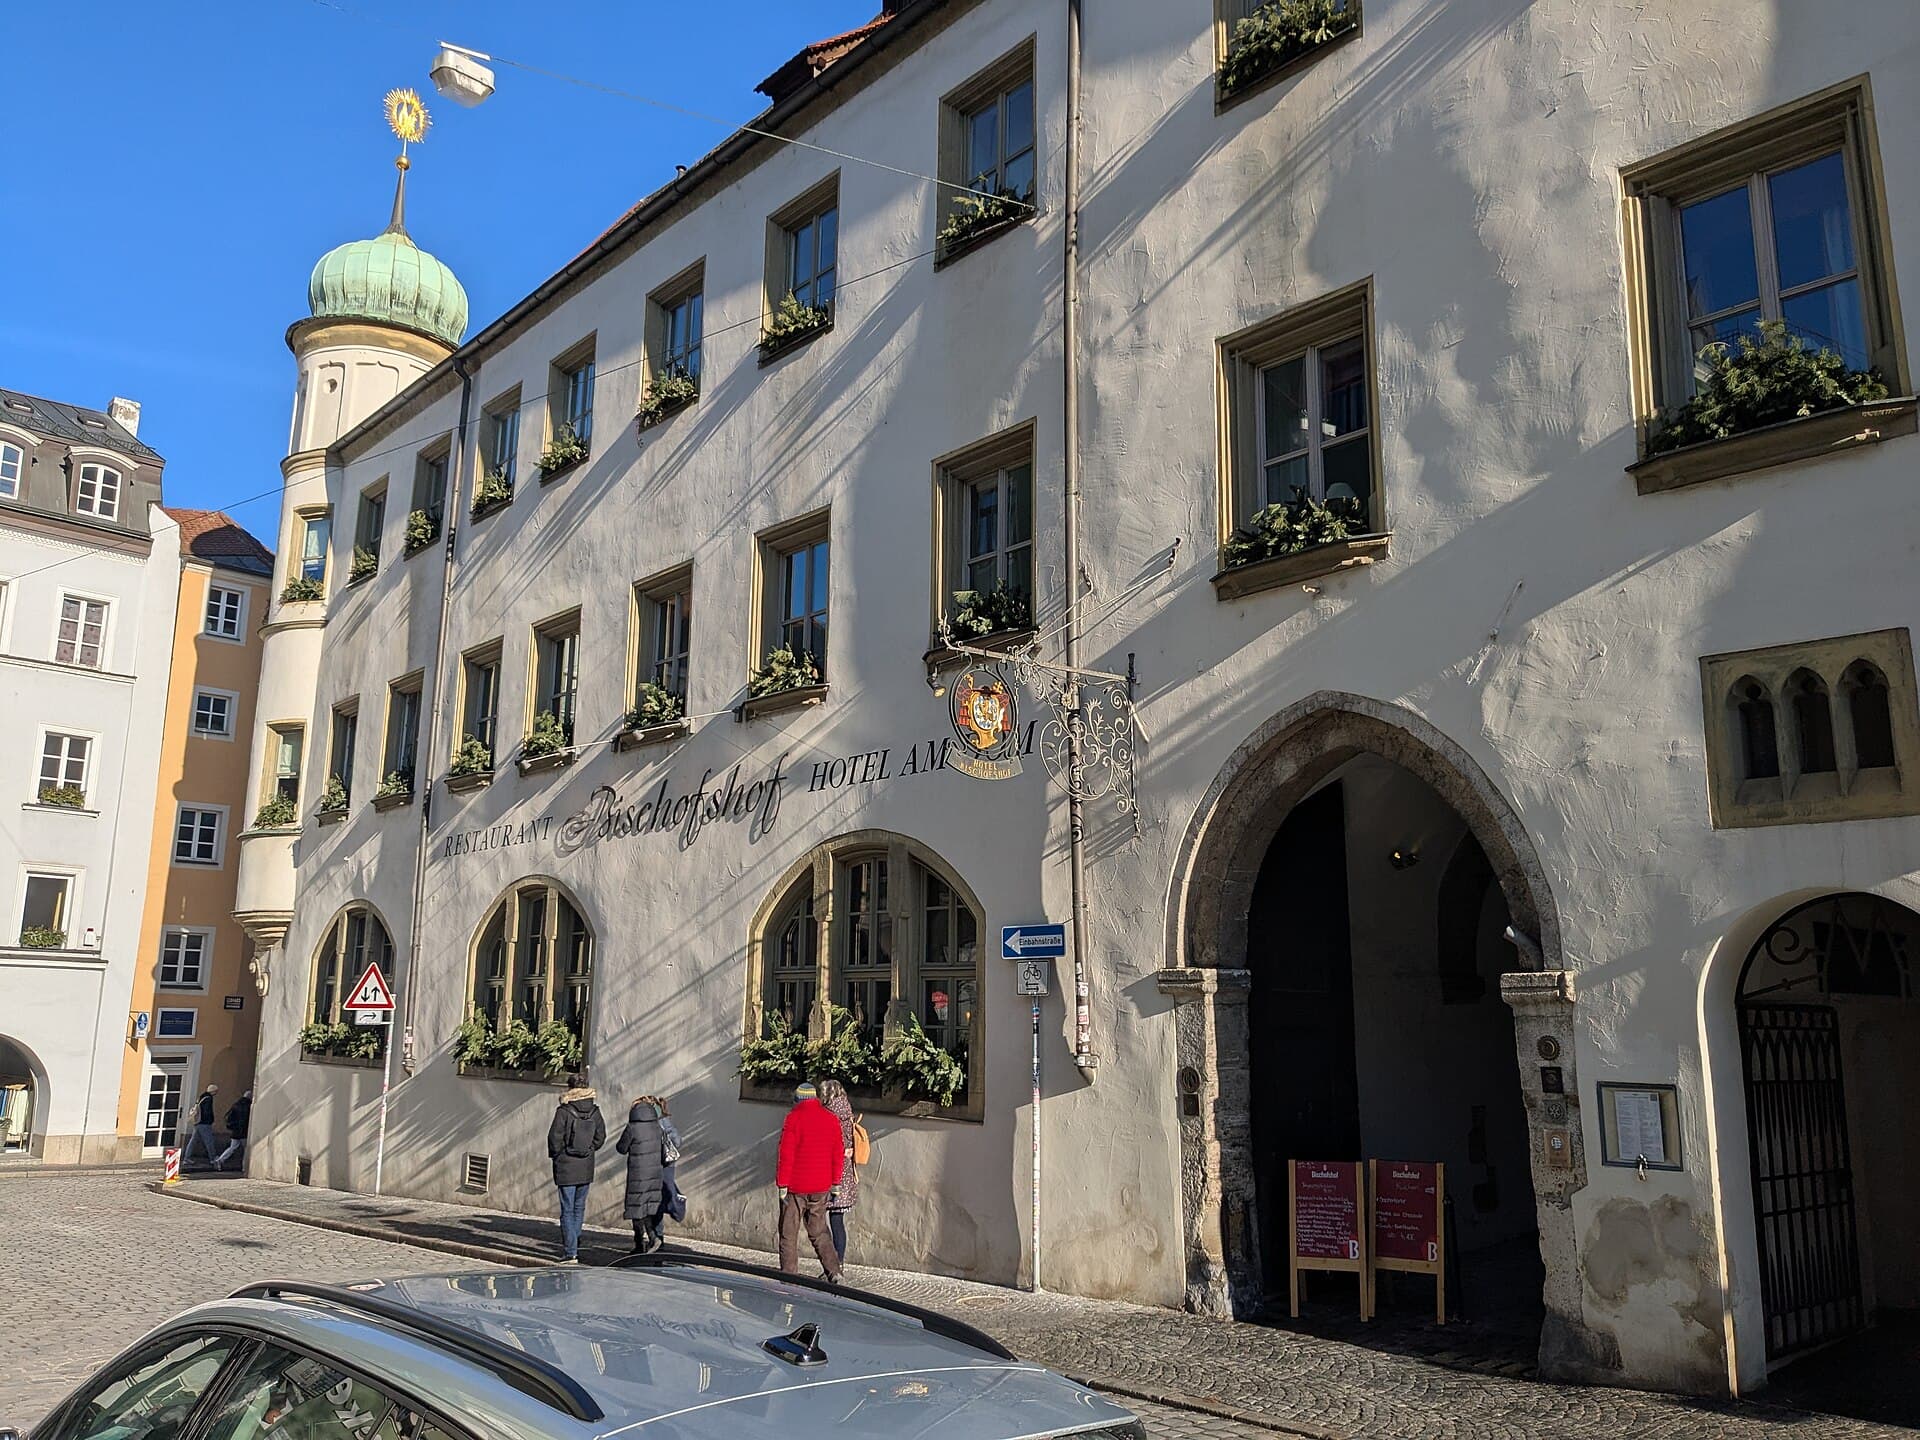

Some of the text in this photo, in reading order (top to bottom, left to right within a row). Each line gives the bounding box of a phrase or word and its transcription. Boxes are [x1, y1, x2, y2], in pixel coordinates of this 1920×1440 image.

[973, 759, 998, 770] HOTEL
[444, 816, 553, 858] RESTAURANT
[558, 753, 789, 856] Bischofshof
[807, 749, 891, 793] HOTEL
[899, 737, 951, 777] AM
[1018, 937, 1062, 946] Einbahnstraße
[1348, 1240, 1360, 1259] B
[1427, 1242, 1438, 1261] B
